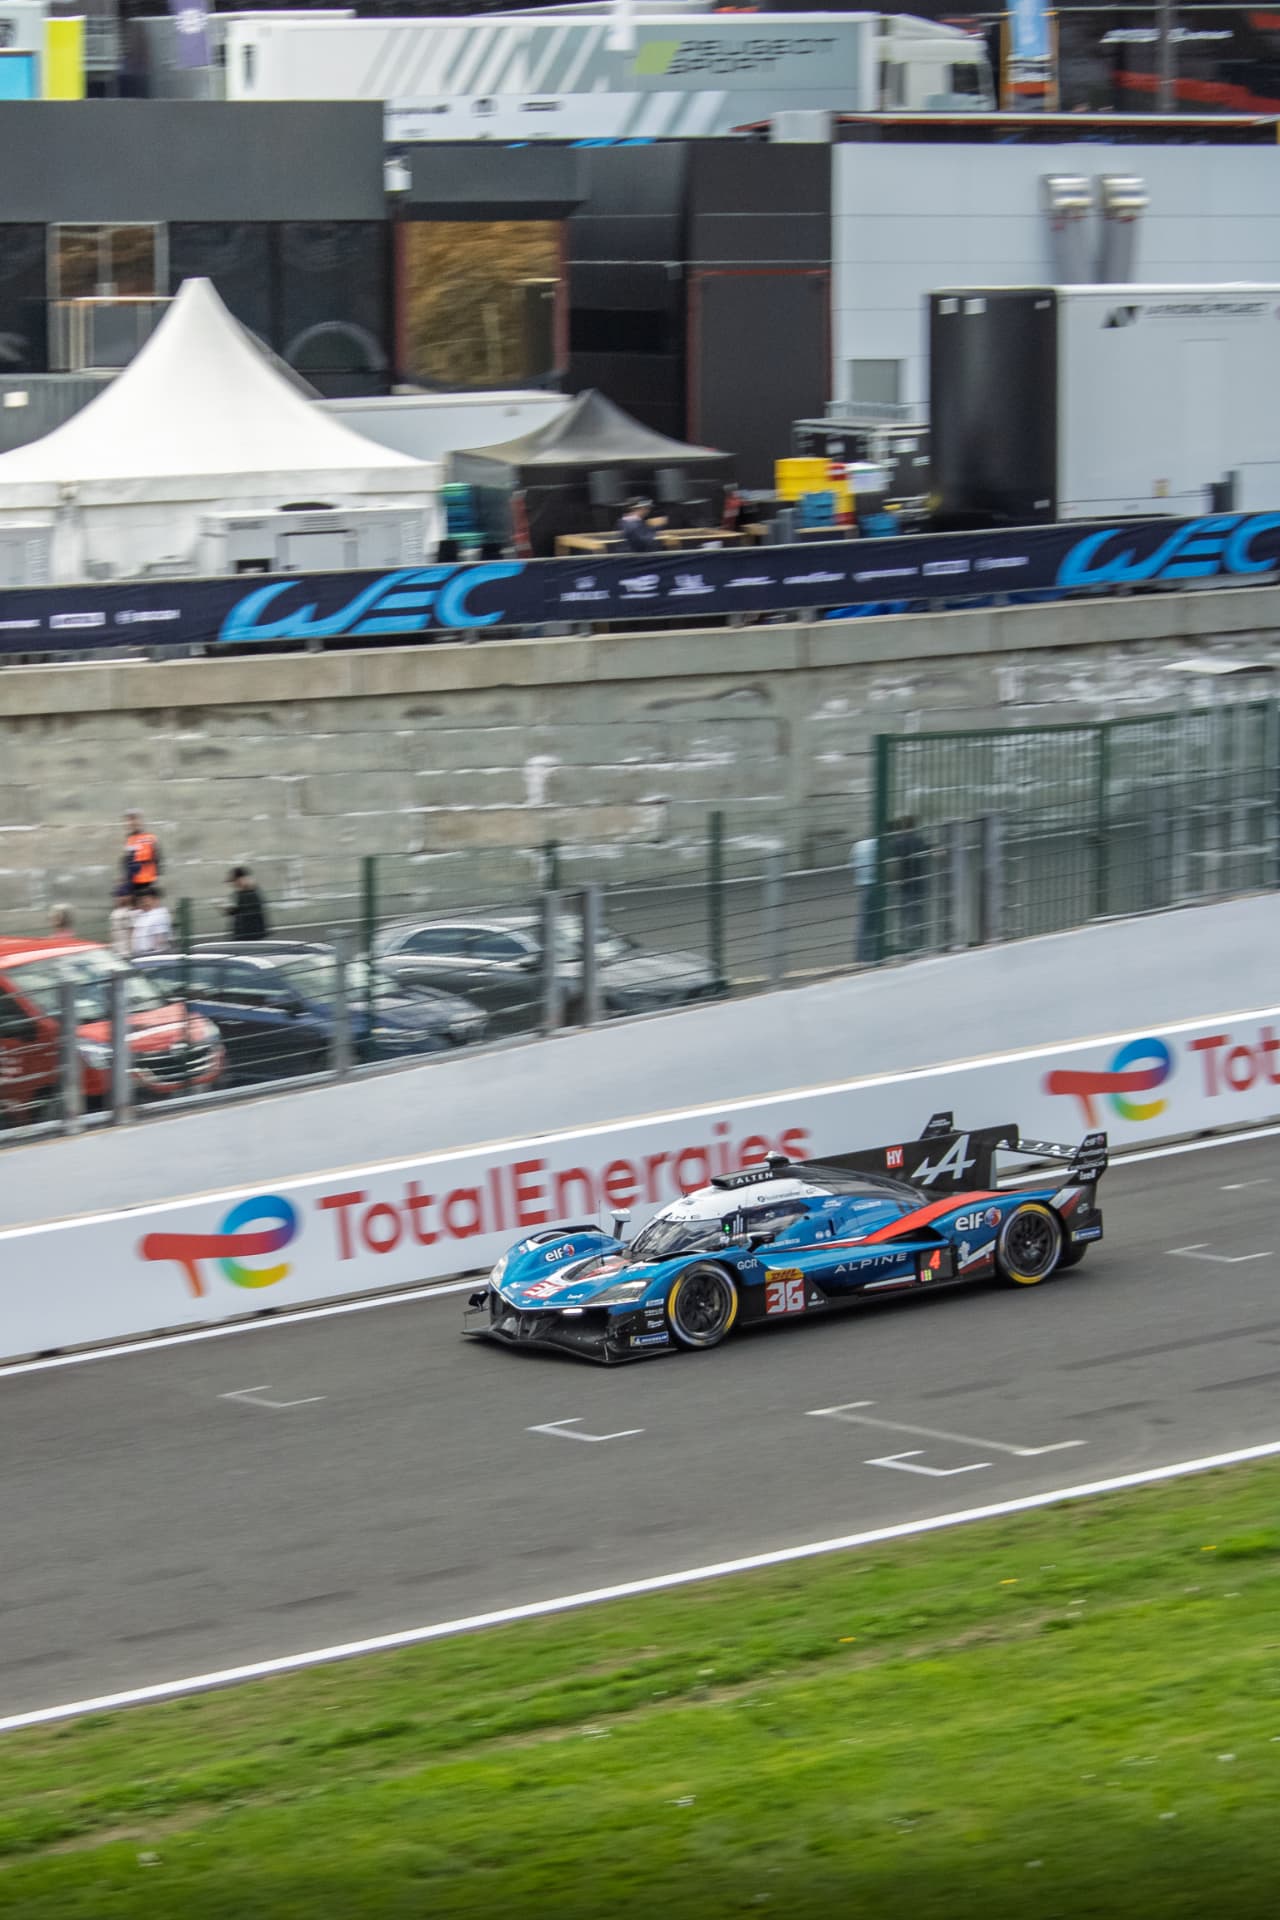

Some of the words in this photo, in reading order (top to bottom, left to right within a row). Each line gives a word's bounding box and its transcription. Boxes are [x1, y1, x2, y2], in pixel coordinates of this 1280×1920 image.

[676, 37, 838, 56] PEUGEOT
[664, 57, 780, 76] SPORT
[219, 562, 527, 642] WEC
[886, 1149, 902, 1165] HY
[736, 1171, 773, 1184] ALTEN
[317, 1123, 813, 1260] TotalEnergies
[955, 1212, 984, 1231] elf
[545, 1247, 565, 1262] elf
[834, 1252, 907, 1274] ALPINE
[929, 1249, 941, 1269] 4
[737, 1258, 758, 1271] GCR
[766, 1279, 804, 1314] 36
